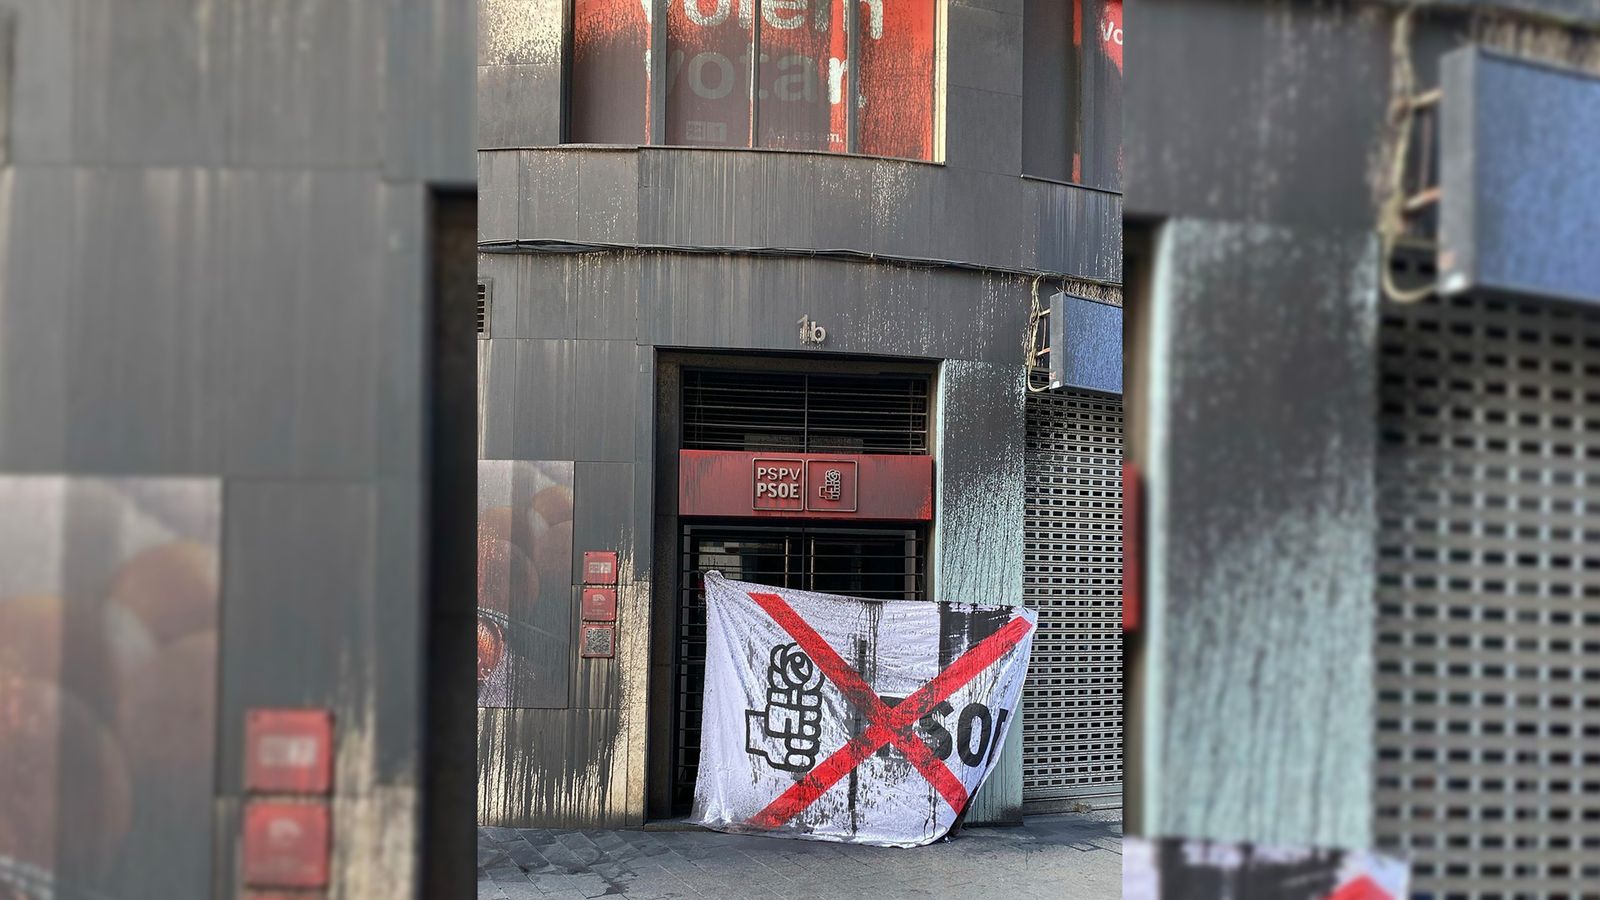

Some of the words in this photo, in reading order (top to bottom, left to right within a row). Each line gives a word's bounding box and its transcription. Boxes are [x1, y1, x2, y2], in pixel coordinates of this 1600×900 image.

[797, 314, 826, 342] 1b
[757, 467, 801, 481] PSPV
[756, 482, 800, 498] PSOE
